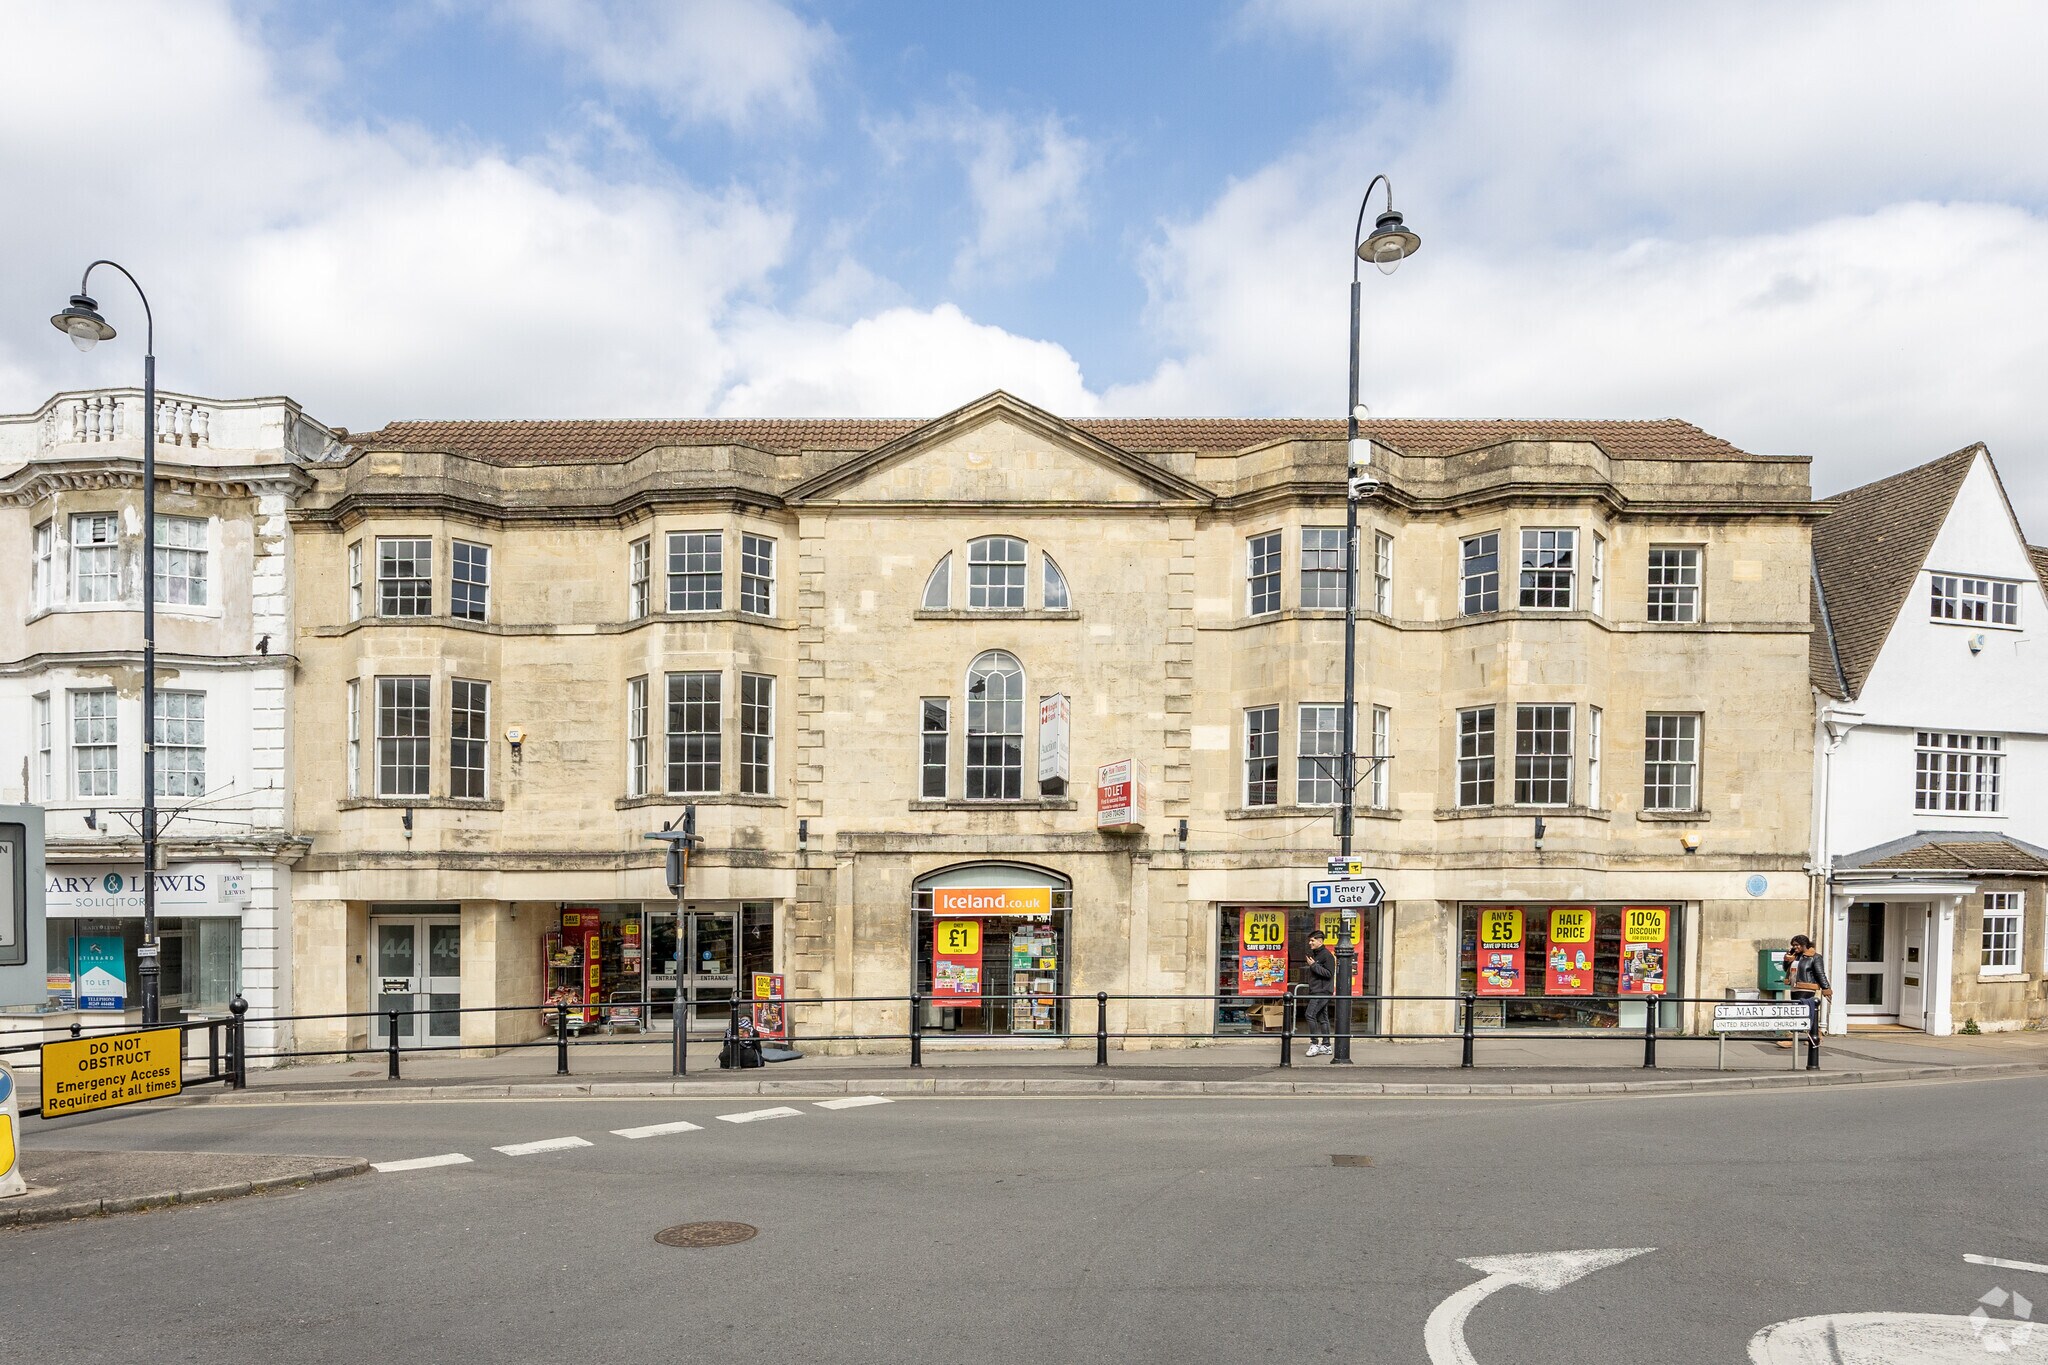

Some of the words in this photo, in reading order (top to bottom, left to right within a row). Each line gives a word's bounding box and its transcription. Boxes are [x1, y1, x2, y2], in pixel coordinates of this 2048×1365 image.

[1104, 787, 1112, 798] TO
[1112, 784, 1123, 796] LET
[224, 875, 245, 883] JEARY
[1316, 888, 1329, 903] P
[1335, 885, 1366, 894] Emery
[943, 894, 1040, 909] Iceland.co.uk
[1338, 894, 1362, 903] Gate
[1253, 914, 1270, 922] ANY
[1270, 914, 1276, 922] 8
[1491, 912, 1507, 921] ANY
[1508, 912, 1514, 920] 5
[1559, 914, 1584, 925] HALF
[1630, 912, 1661, 927] 10%
[949, 929, 968, 947] £1
[1249, 923, 1279, 942] £10
[1324, 924, 1356, 939] FRE
[1491, 922, 1513, 940] £5
[1556, 927, 1585, 938] PRICE
[1629, 927, 1661, 935] DISCOUNT
[381, 938, 412, 958] 44
[432, 938, 460, 958] 45
[1717, 1007, 1731, 1016] ST.
[1736, 1007, 1765, 1016] MARY
[1771, 1006, 1807, 1016] STREET
[90, 1042, 109, 1055] DO
[114, 1038, 141, 1052] NOT
[78, 1051, 151, 1071] OBSTRUCT
[56, 1074, 126, 1094] Emergency
[130, 1067, 170, 1081] Access
[49, 1090, 107, 1110] Required
[111, 1088, 123, 1099] at
[127, 1085, 142, 1096] all
[146, 1080, 177, 1093] times
